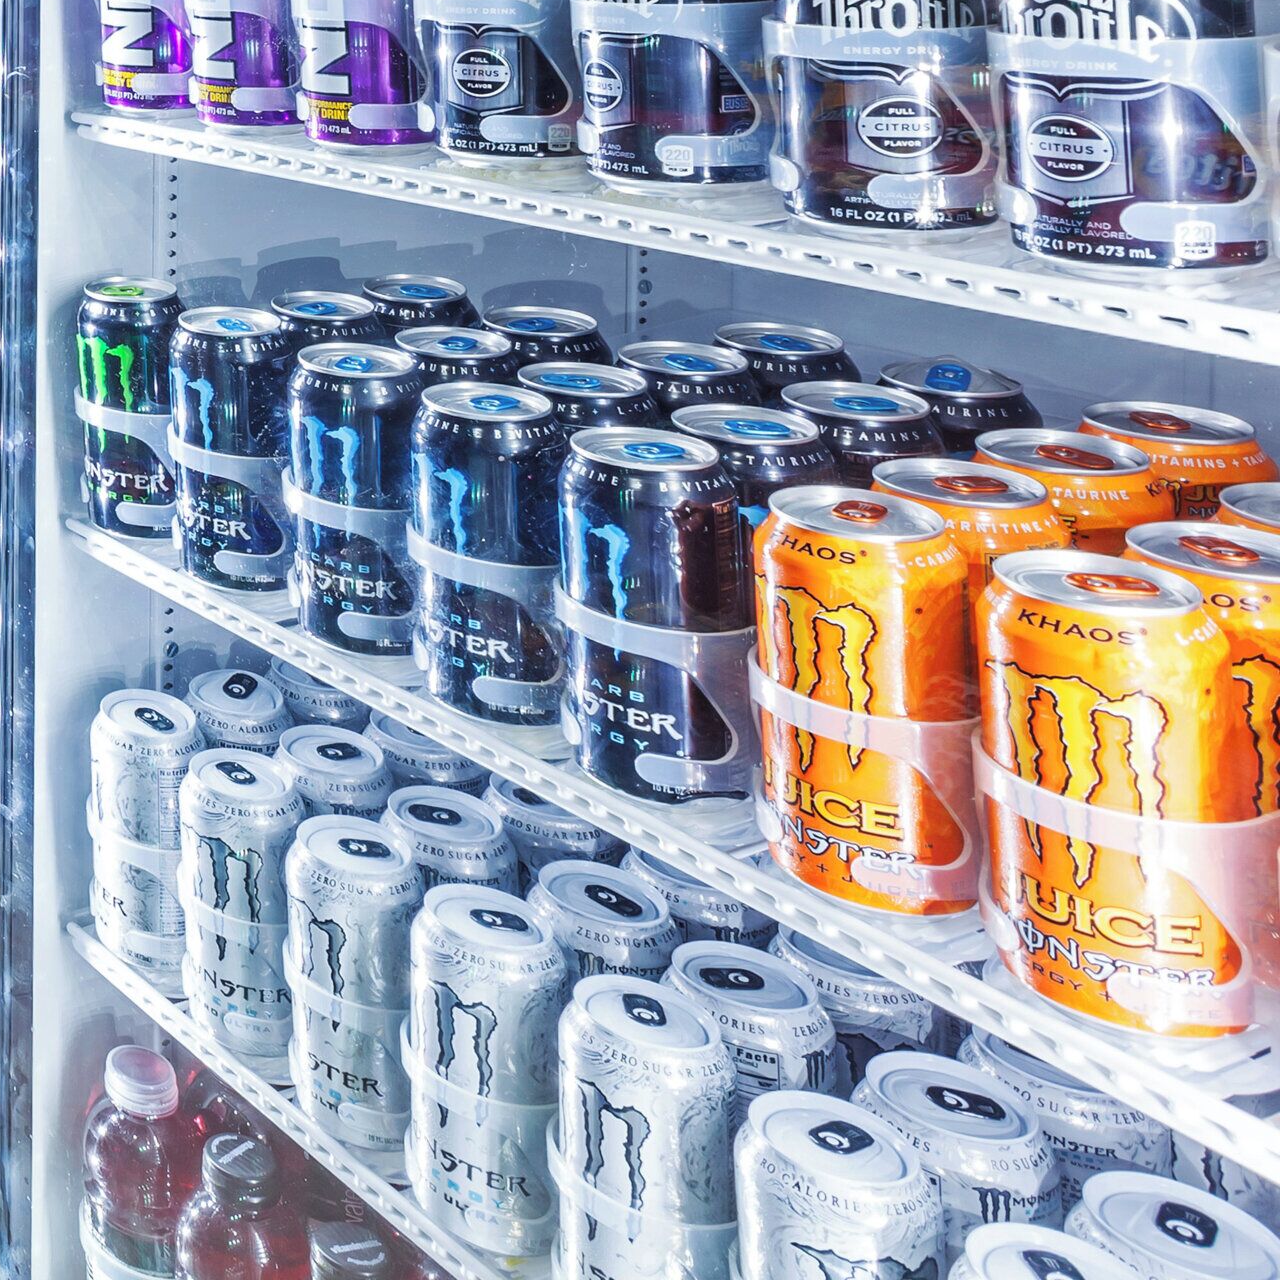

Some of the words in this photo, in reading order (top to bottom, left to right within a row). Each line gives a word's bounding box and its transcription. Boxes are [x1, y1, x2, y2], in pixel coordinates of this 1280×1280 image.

[481, 6, 517, 17] DRINK
[843, 44, 902, 56] ENERGY
[469, 55, 488, 64] FULL
[1065, 59, 1117, 72] DRINK
[461, 68, 500, 78] CITRUS
[467, 82, 492, 90] FLAVOR
[888, 107, 915, 116] FULL
[329, 124, 341, 133] 473
[874, 121, 931, 133] CITRUS
[1050, 125, 1077, 136] FULL
[478, 140, 496, 153] PT)
[497, 142, 517, 152] 473
[518, 142, 536, 154] mL
[884, 138, 922, 148] FLAVOR
[1039, 141, 1095, 155] CITRUS
[665, 148, 691, 161] 220
[611, 162, 630, 173] 473
[631, 164, 649, 175] mL
[1046, 160, 1085, 172] FLAVOR
[830, 207, 843, 219] 16
[846, 208, 862, 220] FL
[864, 210, 885, 222] OZ
[1086, 221, 1112, 231] AND
[1072, 227, 1136, 242] FLAVORED
[1051, 238, 1063, 253] (1
[1066, 239, 1093, 256] PT)
[1095, 243, 1125, 258] 473
[1128, 247, 1156, 260] mL
[418, 362, 479, 376] AURINE
[753, 359, 809, 374] URINE
[656, 381, 735, 396] TAURINE
[819, 425, 921, 442] VITAMINS
[746, 452, 824, 468] TAURINE
[1151, 453, 1226, 469] ITAMINS
[1052, 486, 1130, 501] TAURINE
[781, 534, 857, 565] HAOS
[1016, 608, 1136, 646] KHAOS
[280, 685, 301, 702] ZERO
[303, 696, 356, 708] CALORIES
[582, 690, 684, 741] STER
[204, 717, 230, 731] ZERO
[230, 722, 279, 735] CALORIES
[590, 721, 650, 751] RGY
[328, 782, 357, 792] ZERO
[358, 777, 387, 792] SUGAR
[224, 804, 251, 818] ZERO
[525, 822, 568, 840] SUGAR
[576, 828, 602, 841] ZERO
[415, 841, 445, 858] ZERO
[448, 850, 488, 861] SUGAR
[310, 870, 337, 889] ZERO
[707, 901, 740, 914] ZERO
[1018, 871, 1205, 958] JUICE
[576, 926, 610, 945] ZERO
[614, 934, 657, 949] SUGAR
[453, 947, 485, 966] ZERO
[204, 969, 291, 1004] NSTER
[862, 993, 899, 1005] ZERO
[792, 1022, 819, 1039] ZERO
[601, 1043, 637, 1068] ZERO
[736, 1048, 777, 1065] Facts
[308, 1052, 384, 1098] STER
[1036, 1097, 1101, 1123] SUGAR
[1113, 1110, 1145, 1126] ZERO
[425, 1138, 532, 1198] NSTER
[886, 1199, 916, 1218] ZERO
